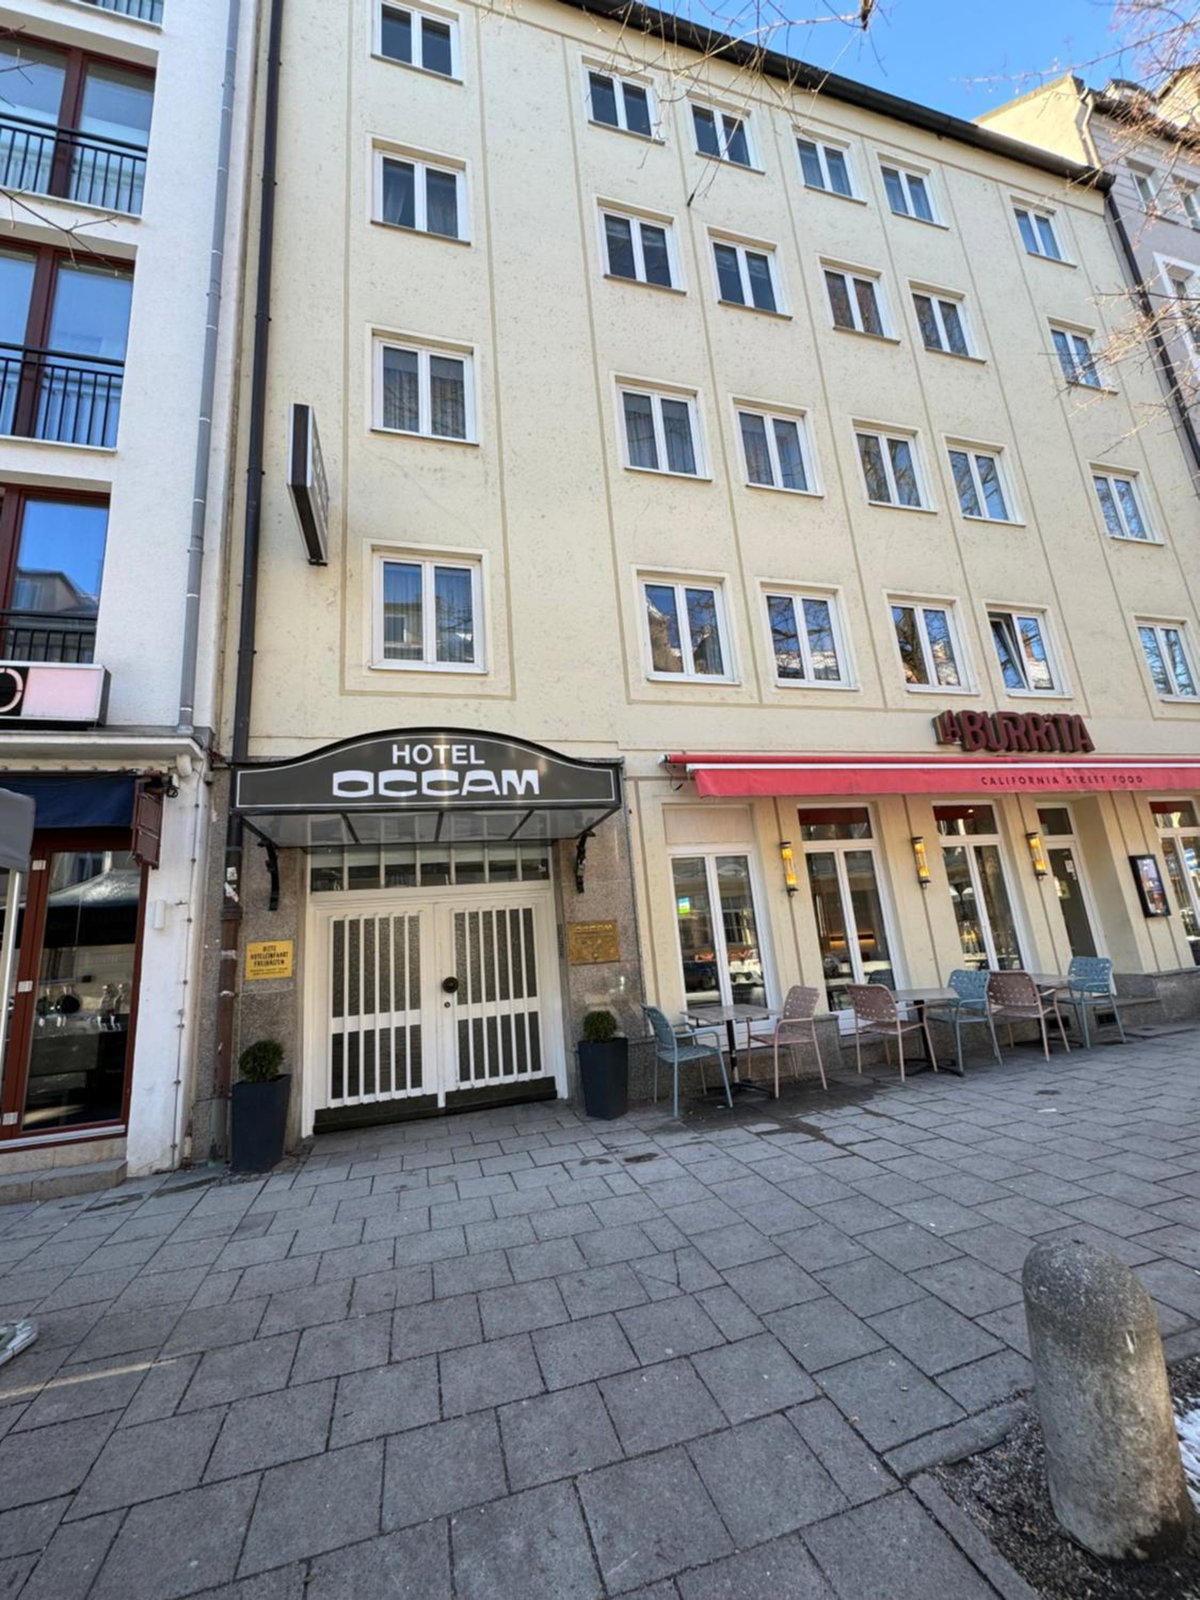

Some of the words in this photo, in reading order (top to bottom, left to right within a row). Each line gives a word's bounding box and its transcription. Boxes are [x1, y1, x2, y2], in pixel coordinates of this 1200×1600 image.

[392, 744, 485, 765] HOTEL
[332, 769, 540, 798] OCCAM
[980, 776, 1060, 786] CALIFORNIA
[1065, 775, 1106, 785] STREET
[1112, 775, 1143, 784] FOOD
